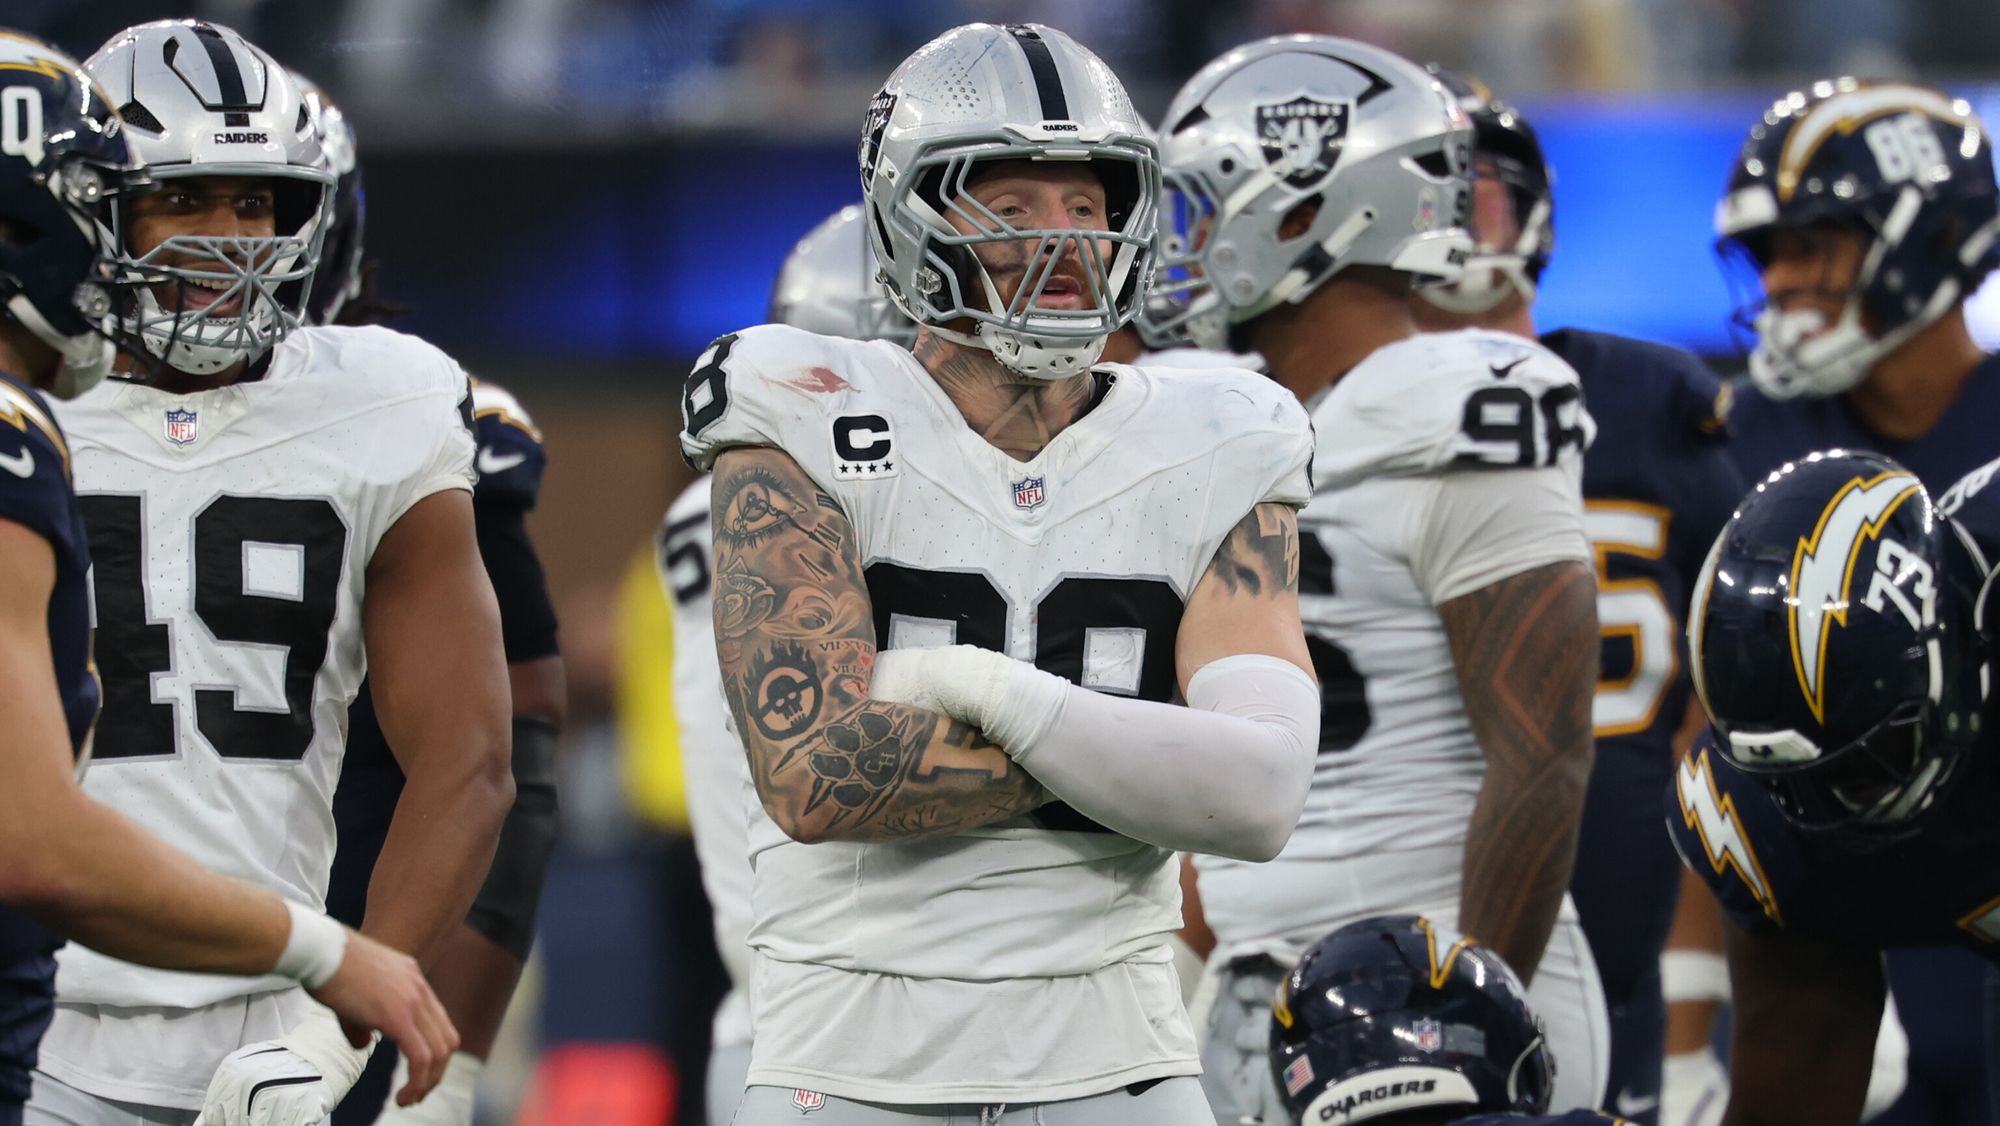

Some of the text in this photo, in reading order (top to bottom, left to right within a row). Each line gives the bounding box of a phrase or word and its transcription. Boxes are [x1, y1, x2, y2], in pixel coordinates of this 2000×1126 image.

[214, 133, 268, 144] RAIDERS
[1864, 113, 1947, 187] 86
[171, 422, 194, 439] NFL
[833, 415, 891, 461] C
[1017, 488, 1042, 504] NFL
[1866, 538, 1934, 632] 73
[797, 1089, 820, 1104] NFL
[1319, 1080, 1437, 1121] CHARGERS
